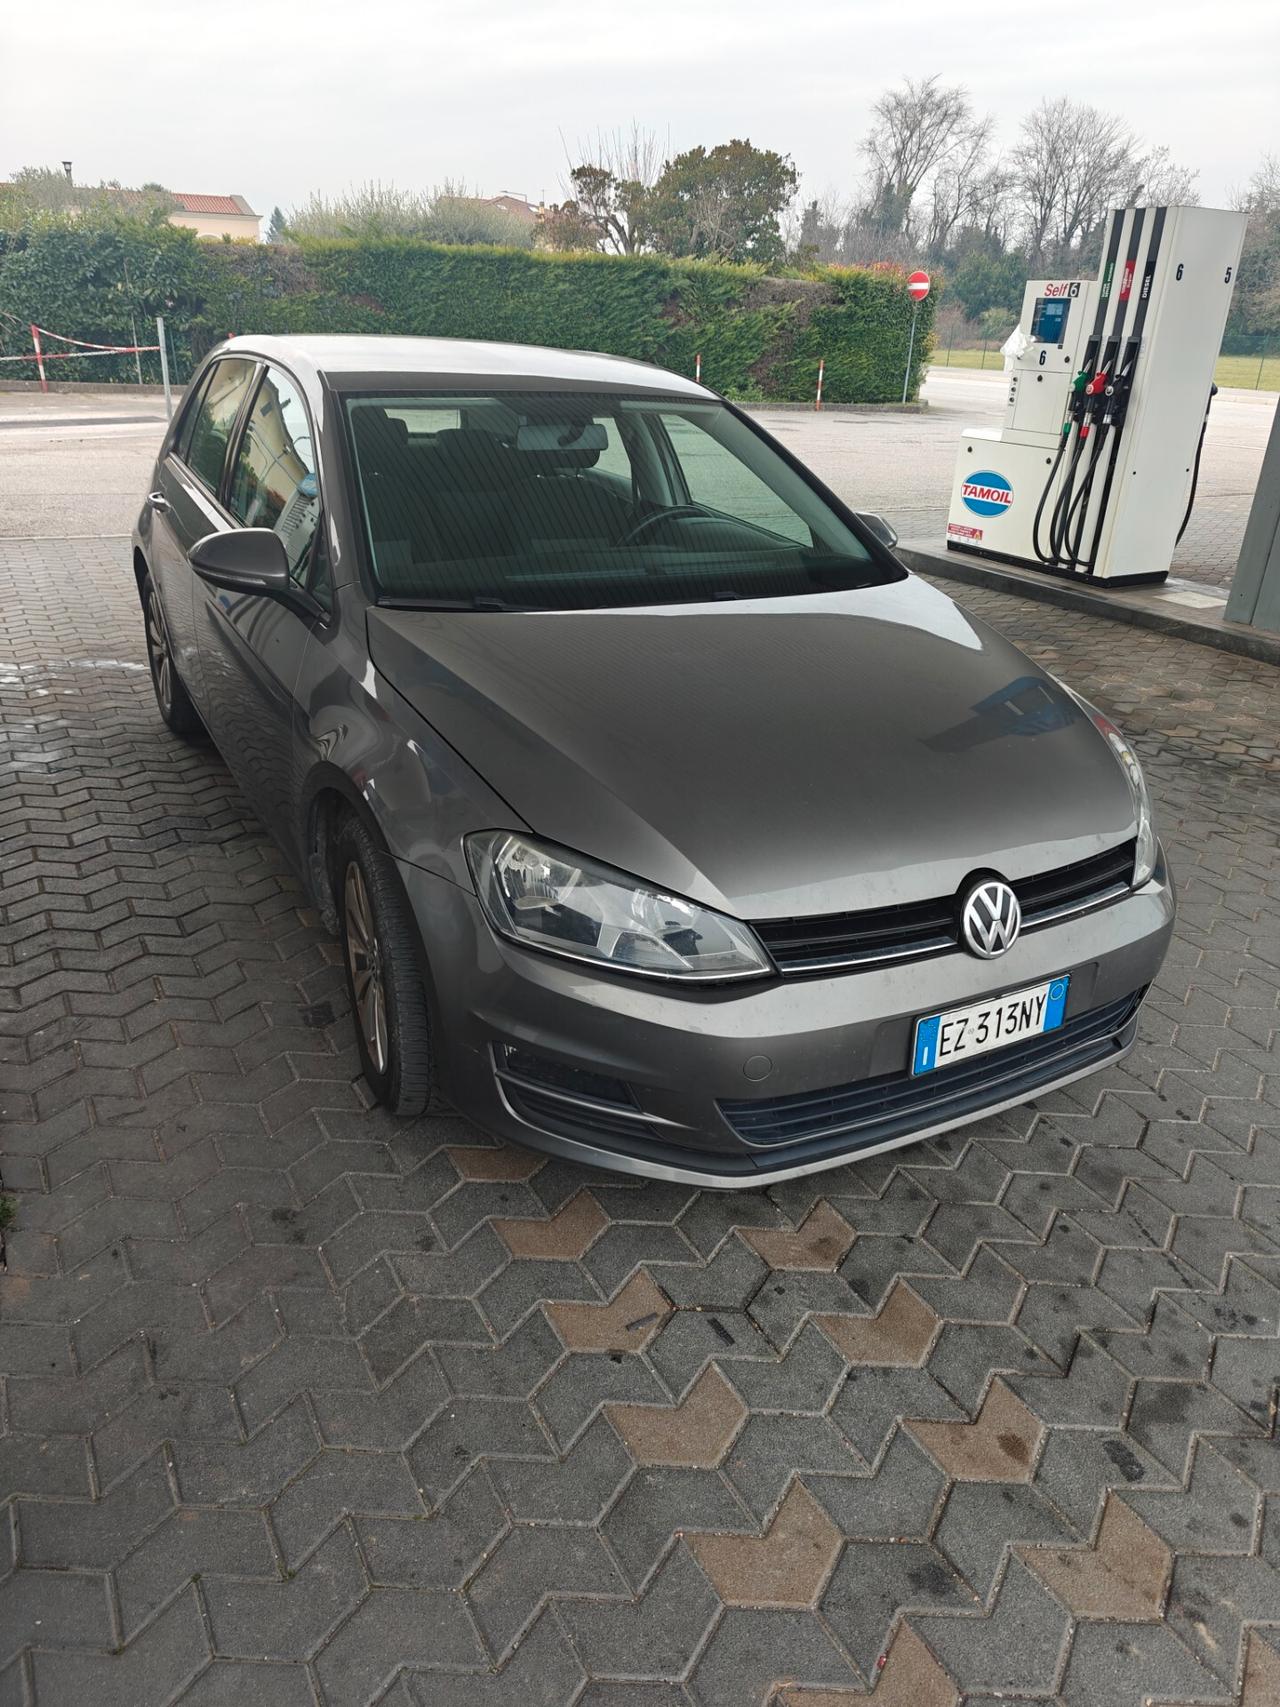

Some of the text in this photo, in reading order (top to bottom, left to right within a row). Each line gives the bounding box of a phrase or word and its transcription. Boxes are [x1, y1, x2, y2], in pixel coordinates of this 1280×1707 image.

[1176, 263, 1184, 281] 6
[1224, 267, 1232, 284] 5
[1044, 283, 1078, 297] Self 6
[1141, 275, 1152, 298] DIESEL
[1039, 350, 1047, 366] 6
[963, 484, 1011, 504] TAMOIL
[939, 993, 1047, 1057] EZ 313NY
